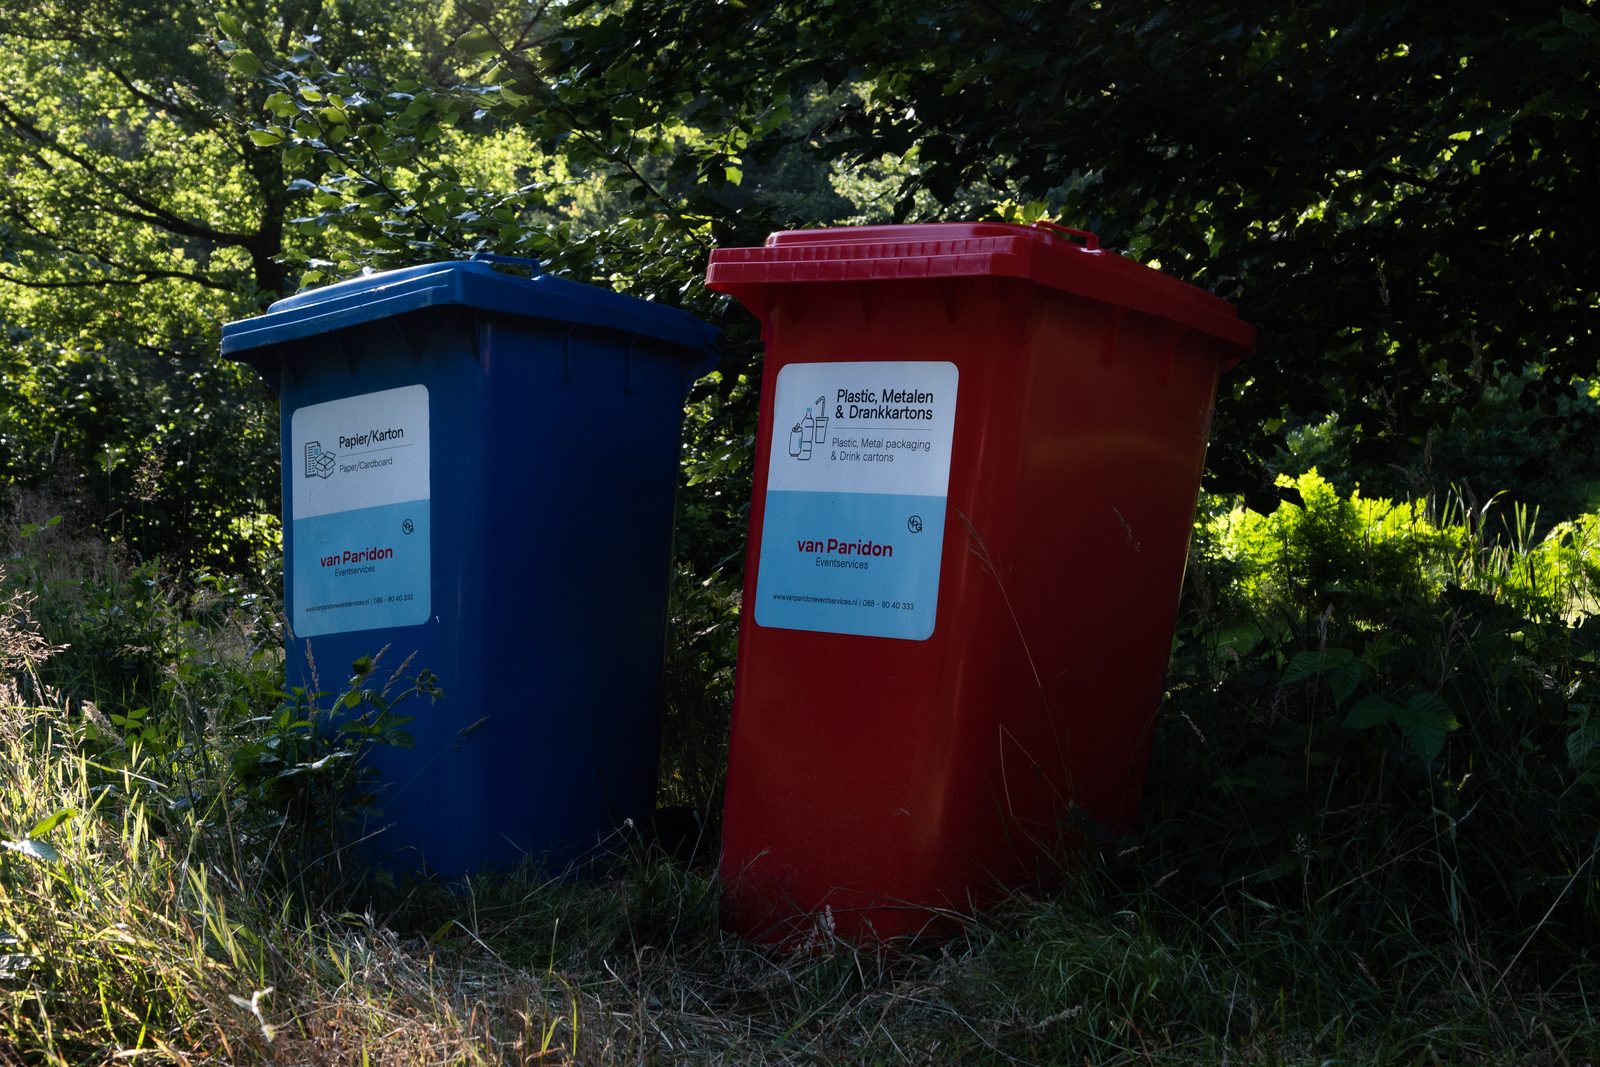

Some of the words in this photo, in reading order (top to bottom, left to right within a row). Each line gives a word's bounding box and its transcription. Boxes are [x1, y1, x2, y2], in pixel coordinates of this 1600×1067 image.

[836, 389, 878, 404] Plastic,
[882, 389, 933, 403] Metalen
[836, 406, 843, 419] &
[849, 405, 932, 420] Drankkartons
[339, 427, 404, 449] Papier/Karton
[832, 438, 859, 448] Plastic,
[861, 438, 883, 448] Metal
[886, 438, 931, 452] packaging
[831, 451, 837, 460] &
[840, 452, 860, 461] Drink
[863, 453, 894, 462] cartons
[340, 457, 393, 473] Paper/Cardboard
[797, 539, 823, 553] van
[827, 539, 893, 557] Paridon
[320, 553, 340, 568] van
[343, 546, 393, 564] Paridon
[816, 558, 868, 569] Eventservices
[334, 565, 375, 577] Eventservices
[373, 595, 383, 604] 088
[388, 595, 395, 603] 80
[396, 594, 402, 602] 40
[404, 593, 413, 601] 333
[773, 593, 858, 606] www.vanparidoneventservices.nl
[892, 602, 900, 610] 40
[902, 602, 914, 610] 333
